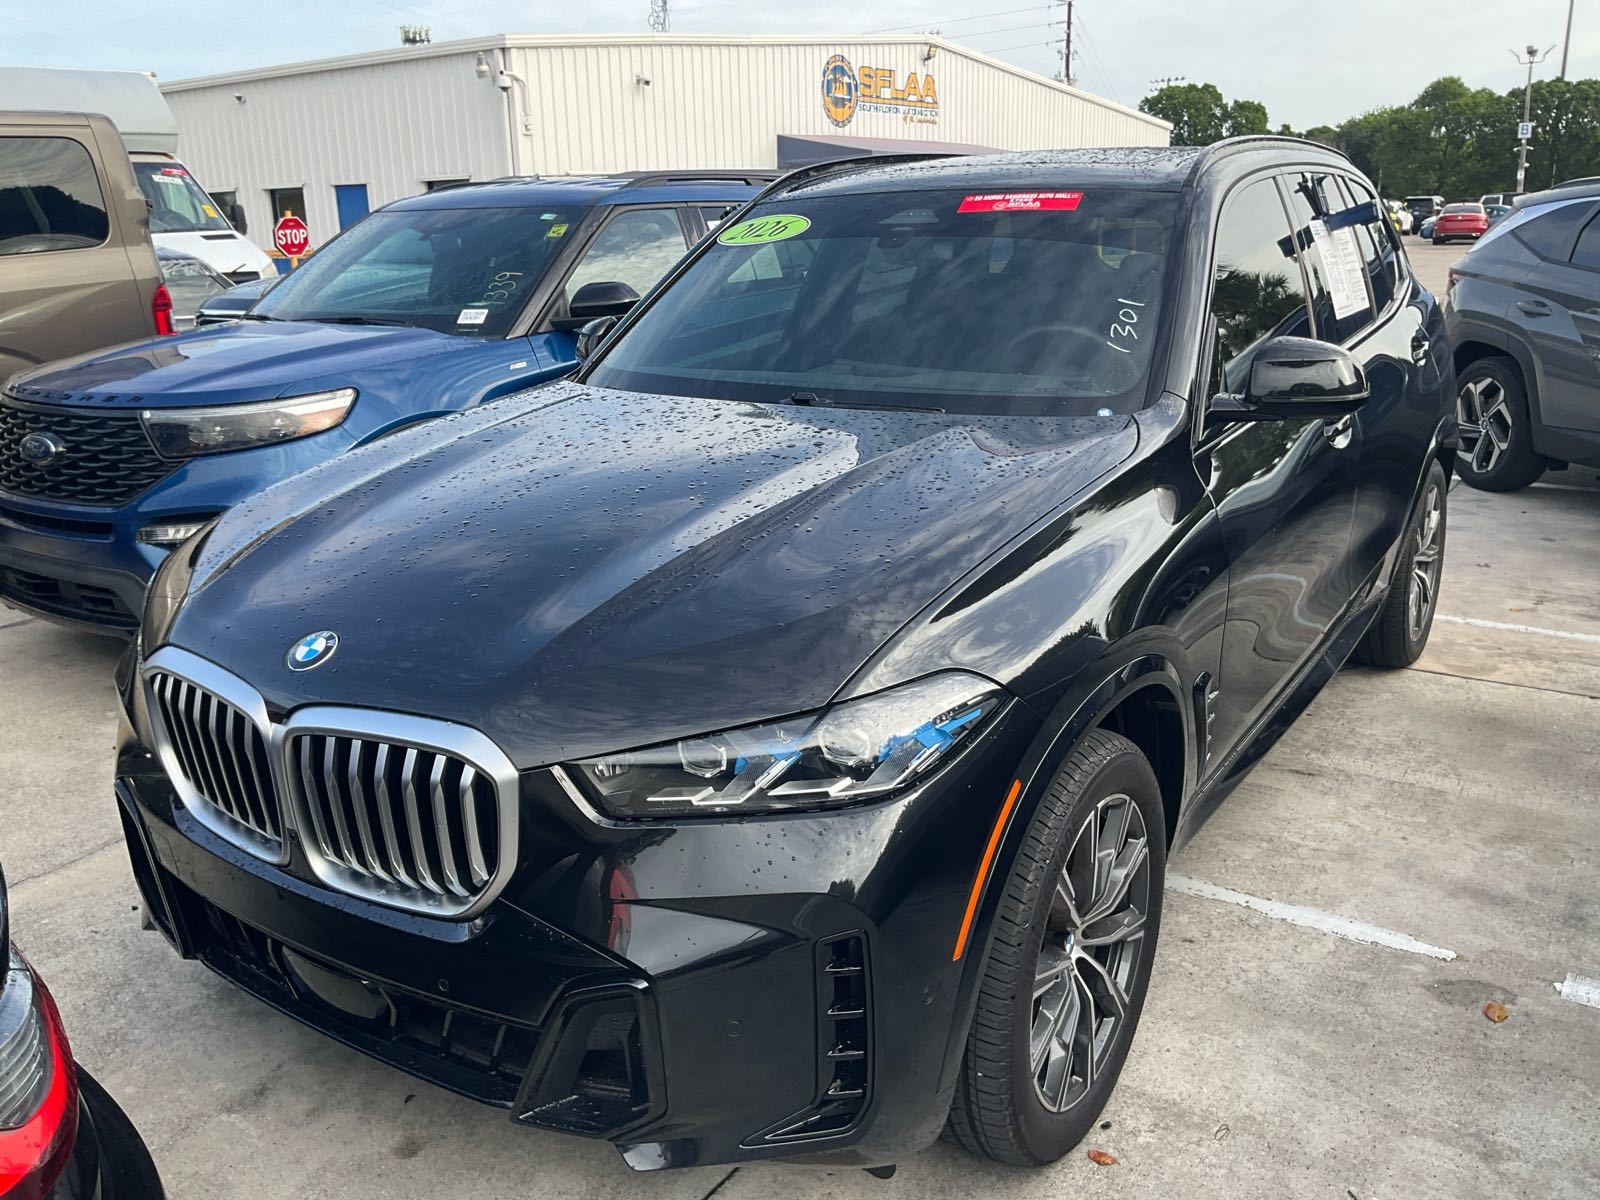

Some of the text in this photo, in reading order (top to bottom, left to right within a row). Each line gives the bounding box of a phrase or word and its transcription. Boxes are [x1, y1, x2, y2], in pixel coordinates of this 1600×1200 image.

[858, 66, 938, 103] SFLAA
[858, 103, 878, 113] SOUTH
[879, 105, 901, 115] FLORIDA
[277, 229, 307, 245] STOP
[726, 219, 801, 241] 2026
[1106, 298, 1145, 353] 1301
